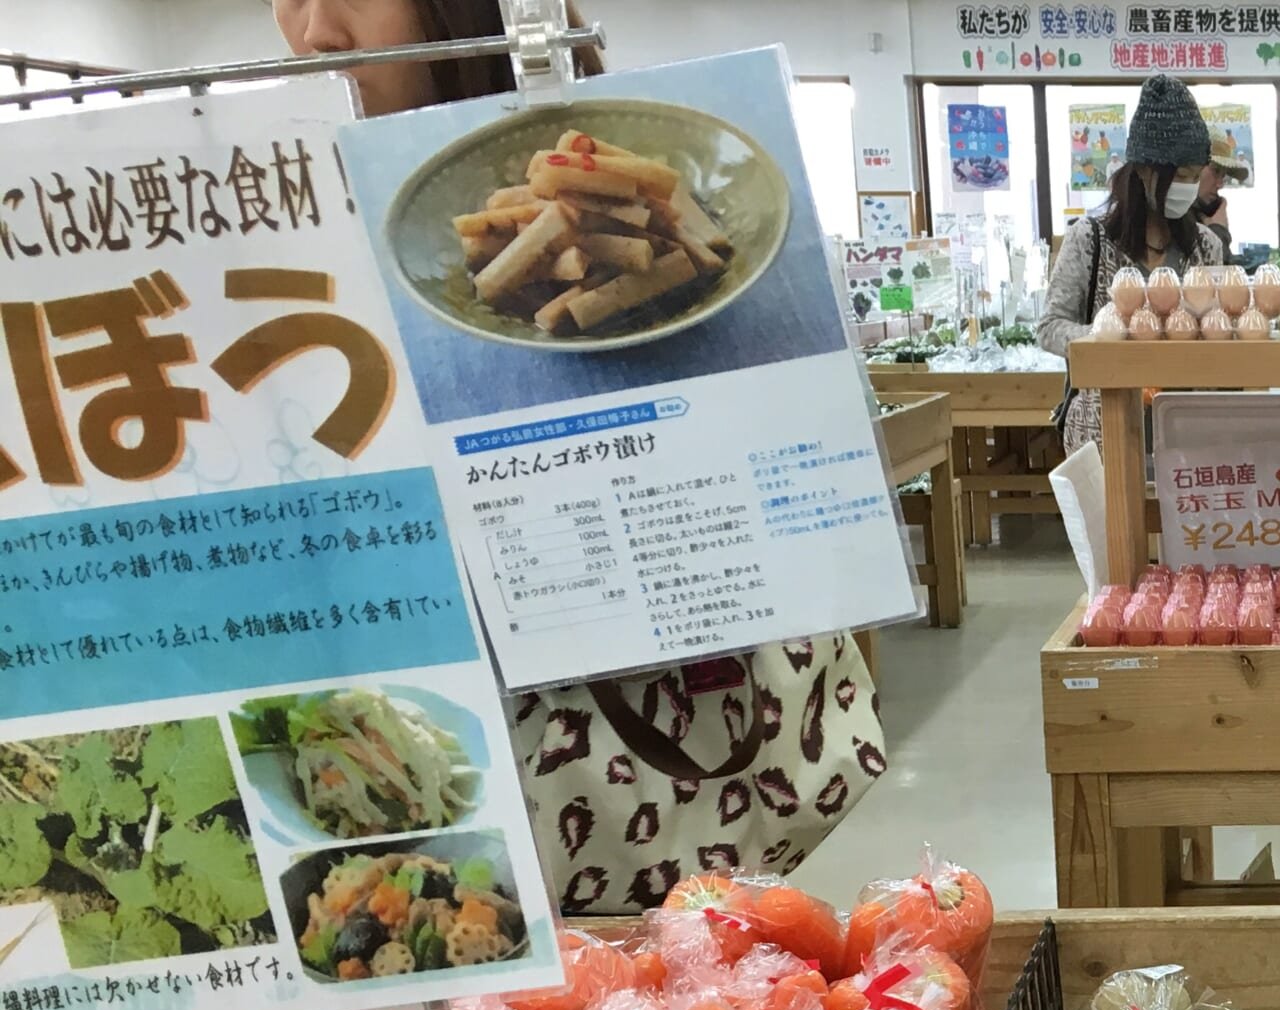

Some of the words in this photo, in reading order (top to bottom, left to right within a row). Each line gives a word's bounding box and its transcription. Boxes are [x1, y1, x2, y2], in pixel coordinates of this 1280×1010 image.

[959, 8, 1029, 35] 私たちが
[1041, 9, 1117, 35] 安全・安心な
[1112, 43, 1227, 69] 地産地消推進
[846, 246, 903, 263] ハンダマ
[0, 268, 397, 490] ぼう
[466, 431, 657, 485] かんたんゴボウ漬け
[611, 475, 636, 487] 作り方
[1173, 463, 1257, 489] 石垣島産
[616, 493, 622, 503] 1
[1176, 491, 1246, 514] 赤玉
[478, 515, 505, 527] ゴボウ
[496, 528, 523, 540] だし汁
[573, 514, 606, 527] 300mL
[623, 523, 632, 534] 2
[500, 543, 528, 555] みりん
[578, 529, 610, 541] 100mL
[504, 557, 540, 571] しょうゆ
[582, 544, 614, 556] 100mL
[493, 572, 502, 581] A
[508, 574, 527, 585] みそ
[585, 558, 618, 572] 小さじ1
[602, 588, 626, 600] 1本分
[640, 583, 648, 594] 3
[654, 628, 661, 637] 4
